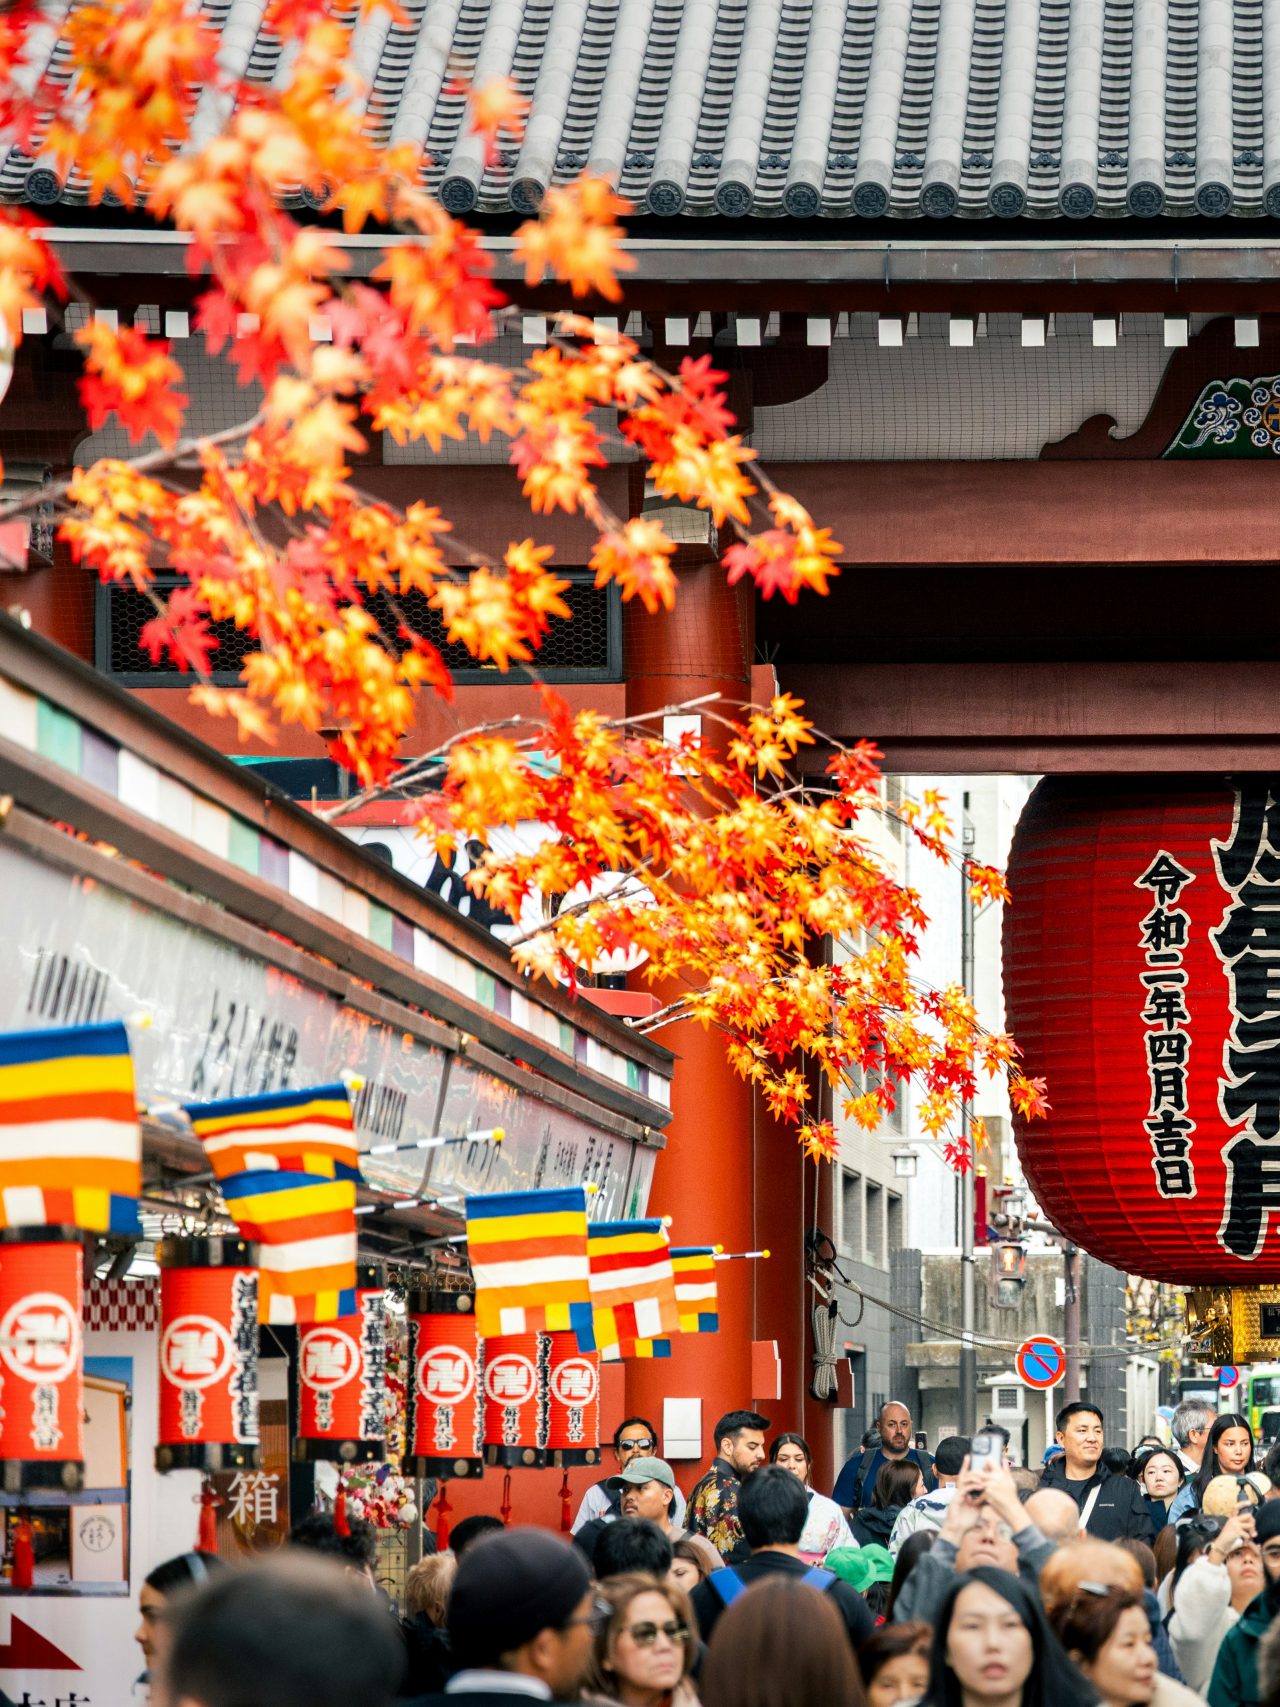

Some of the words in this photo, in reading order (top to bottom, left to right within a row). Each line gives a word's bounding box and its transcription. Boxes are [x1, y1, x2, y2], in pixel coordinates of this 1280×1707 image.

[1135, 851, 1196, 1198] 令和二年四月吉日
[227, 1471, 280, 1525] 箱
